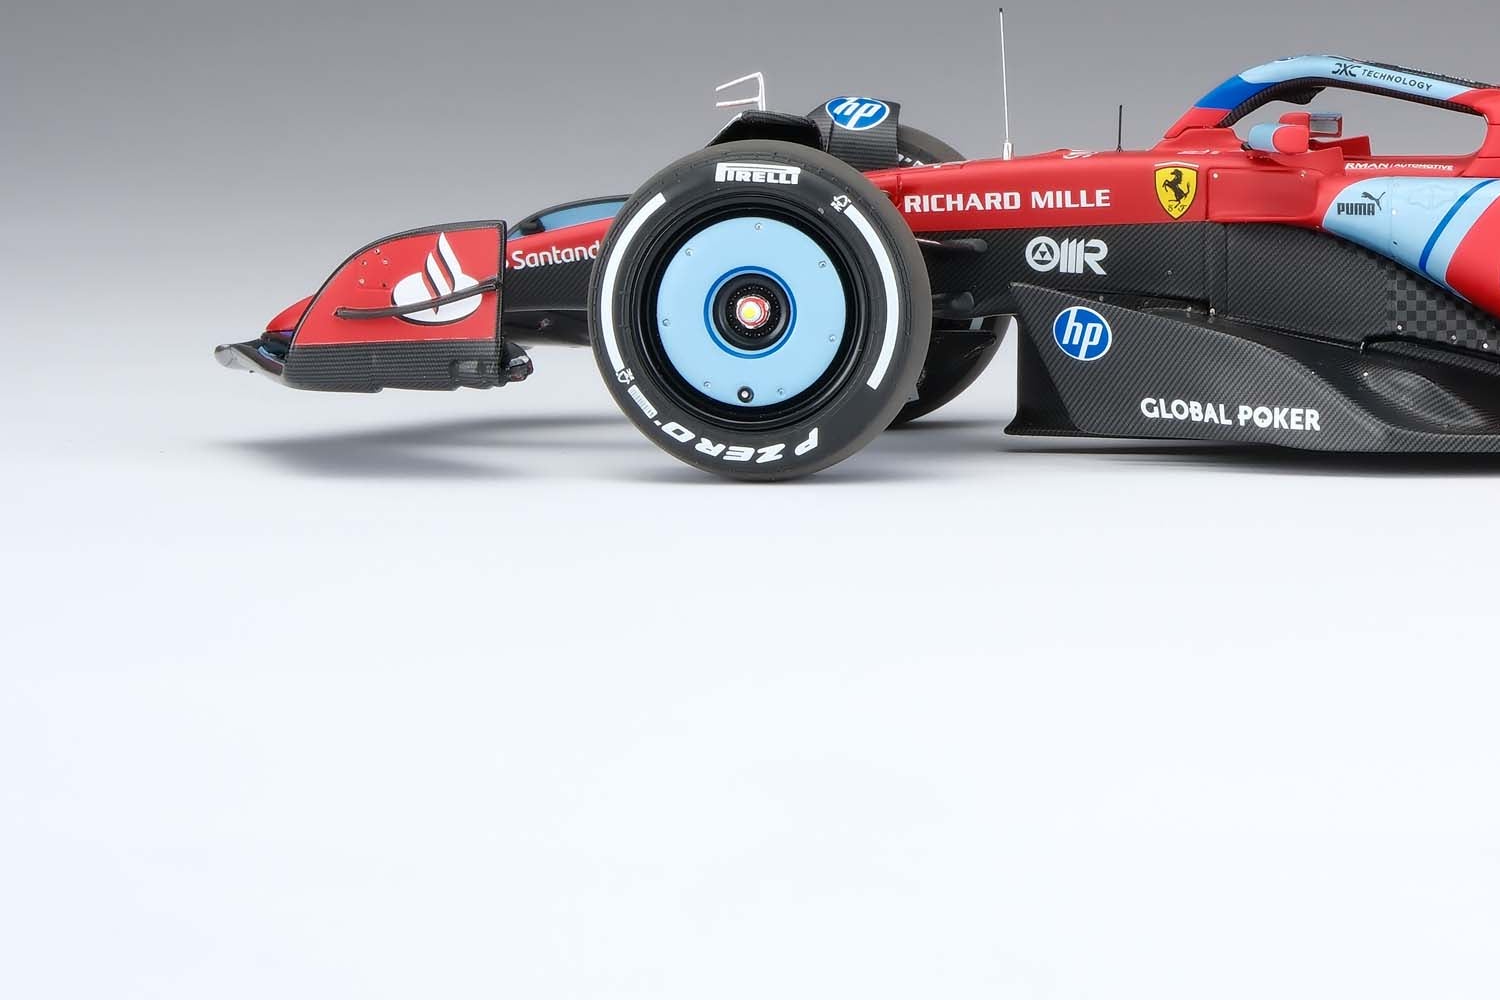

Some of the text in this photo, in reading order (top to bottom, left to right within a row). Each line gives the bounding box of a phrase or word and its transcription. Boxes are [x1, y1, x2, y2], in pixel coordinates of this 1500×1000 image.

[1361, 69, 1432, 91] TECHNOLOGY
[833, 98, 875, 129] hp
[715, 162, 801, 184] PIRELLI
[1345, 162, 1454, 171] RMAN AUTOMOTIVE
[904, 189, 1110, 213] RICHARD MILLE
[1337, 203, 1375, 215] PUMA
[511, 239, 600, 270] Santand
[1062, 307, 1102, 360] hp
[1140, 397, 1321, 431] GLOBAL POKER
[661, 421, 819, 463] P ZERO
